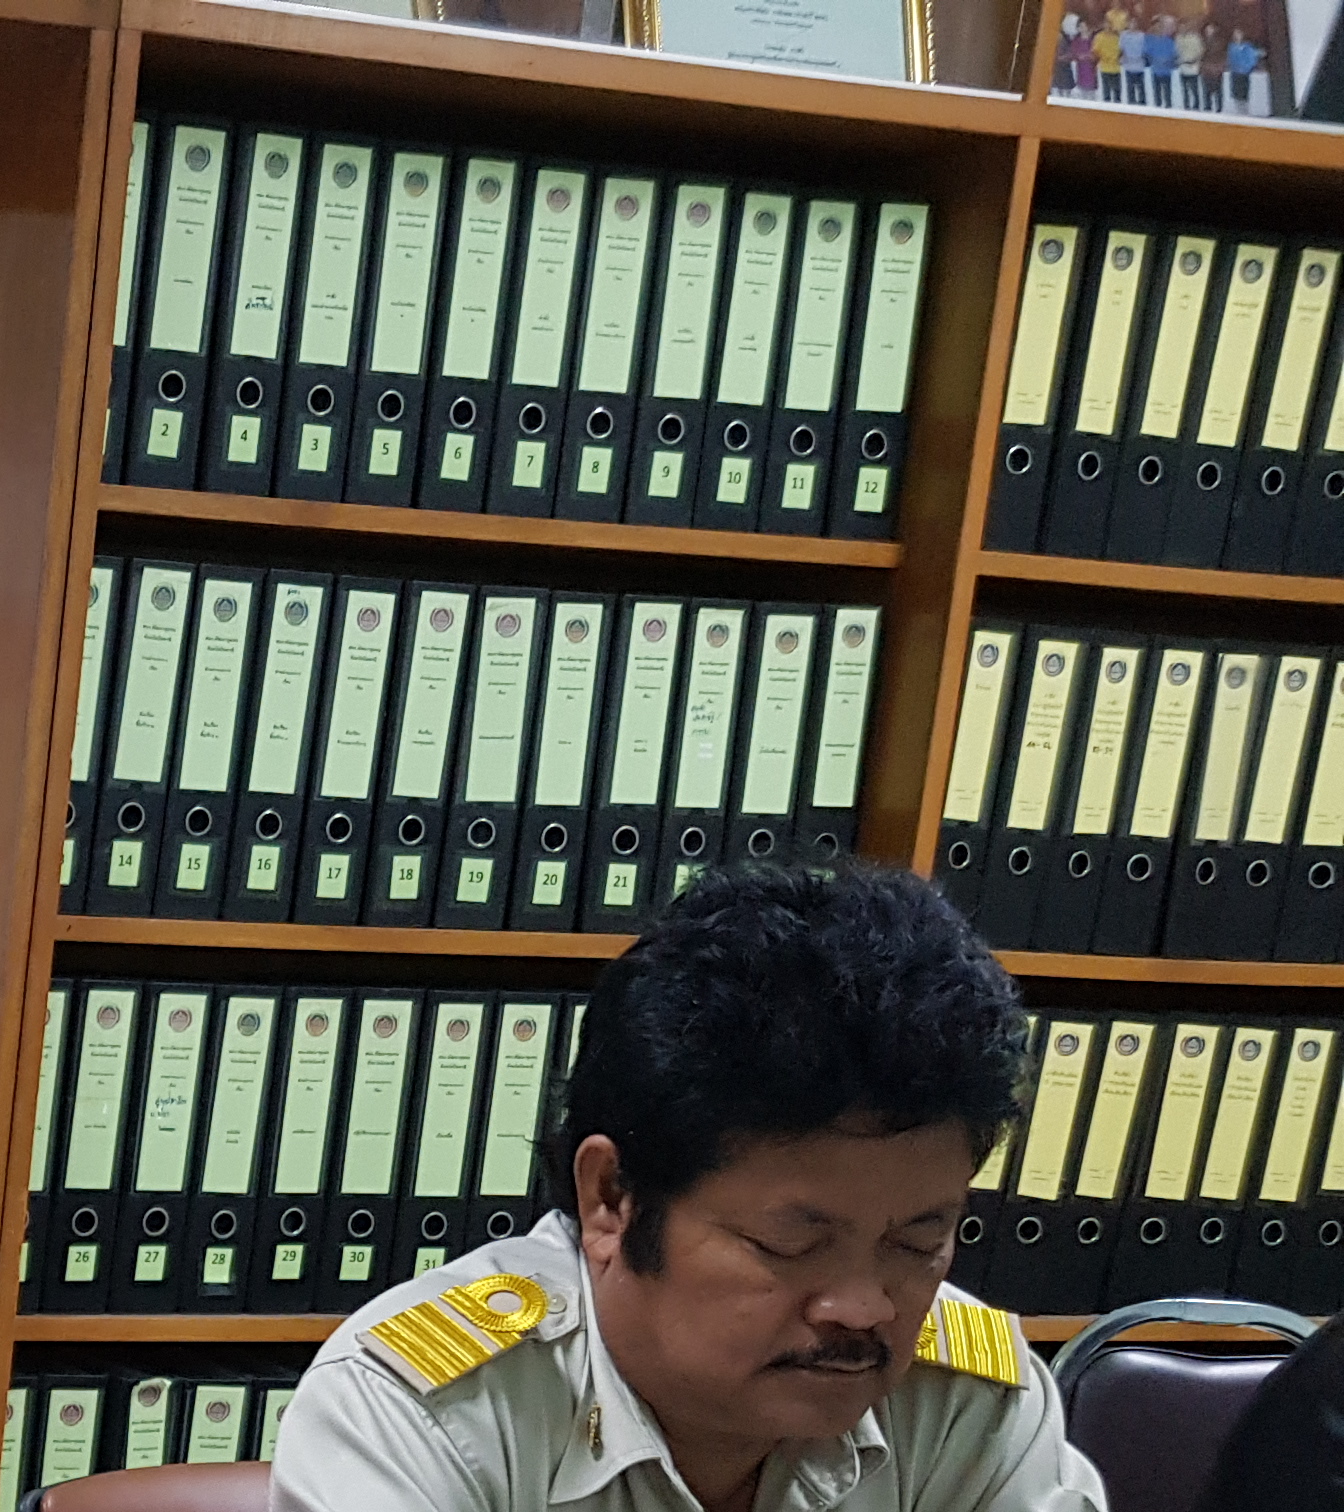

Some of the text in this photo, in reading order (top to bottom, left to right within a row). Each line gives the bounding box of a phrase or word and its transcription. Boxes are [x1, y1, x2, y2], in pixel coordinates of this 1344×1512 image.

[160, 422, 169, 437] 2
[240, 429, 248, 442] 4
[310, 438, 319, 451] 3
[381, 442, 390, 456] 5
[453, 446, 462, 460] 6
[526, 454, 535, 468] 7
[591, 460, 600, 474] 8
[661, 465, 671, 478] 9
[727, 471, 742, 485] 10
[792, 477, 805, 490] 11
[864, 480, 879, 494] 12
[118, 854, 133, 867] 14
[186, 857, 201, 871] 15
[257, 858, 272, 871] 16
[326, 867, 342, 880] 17
[399, 868, 414, 881] 18
[468, 870, 484, 884] 19
[542, 873, 558, 886] 20
[612, 875, 628, 888] 21
[75, 1251, 90, 1263] 26
[144, 1251, 160, 1263] 27
[211, 1253, 226, 1265] 28
[282, 1250, 297, 1262] 29
[349, 1251, 365, 1263] 30
[422, 1258, 437, 1271] 31
